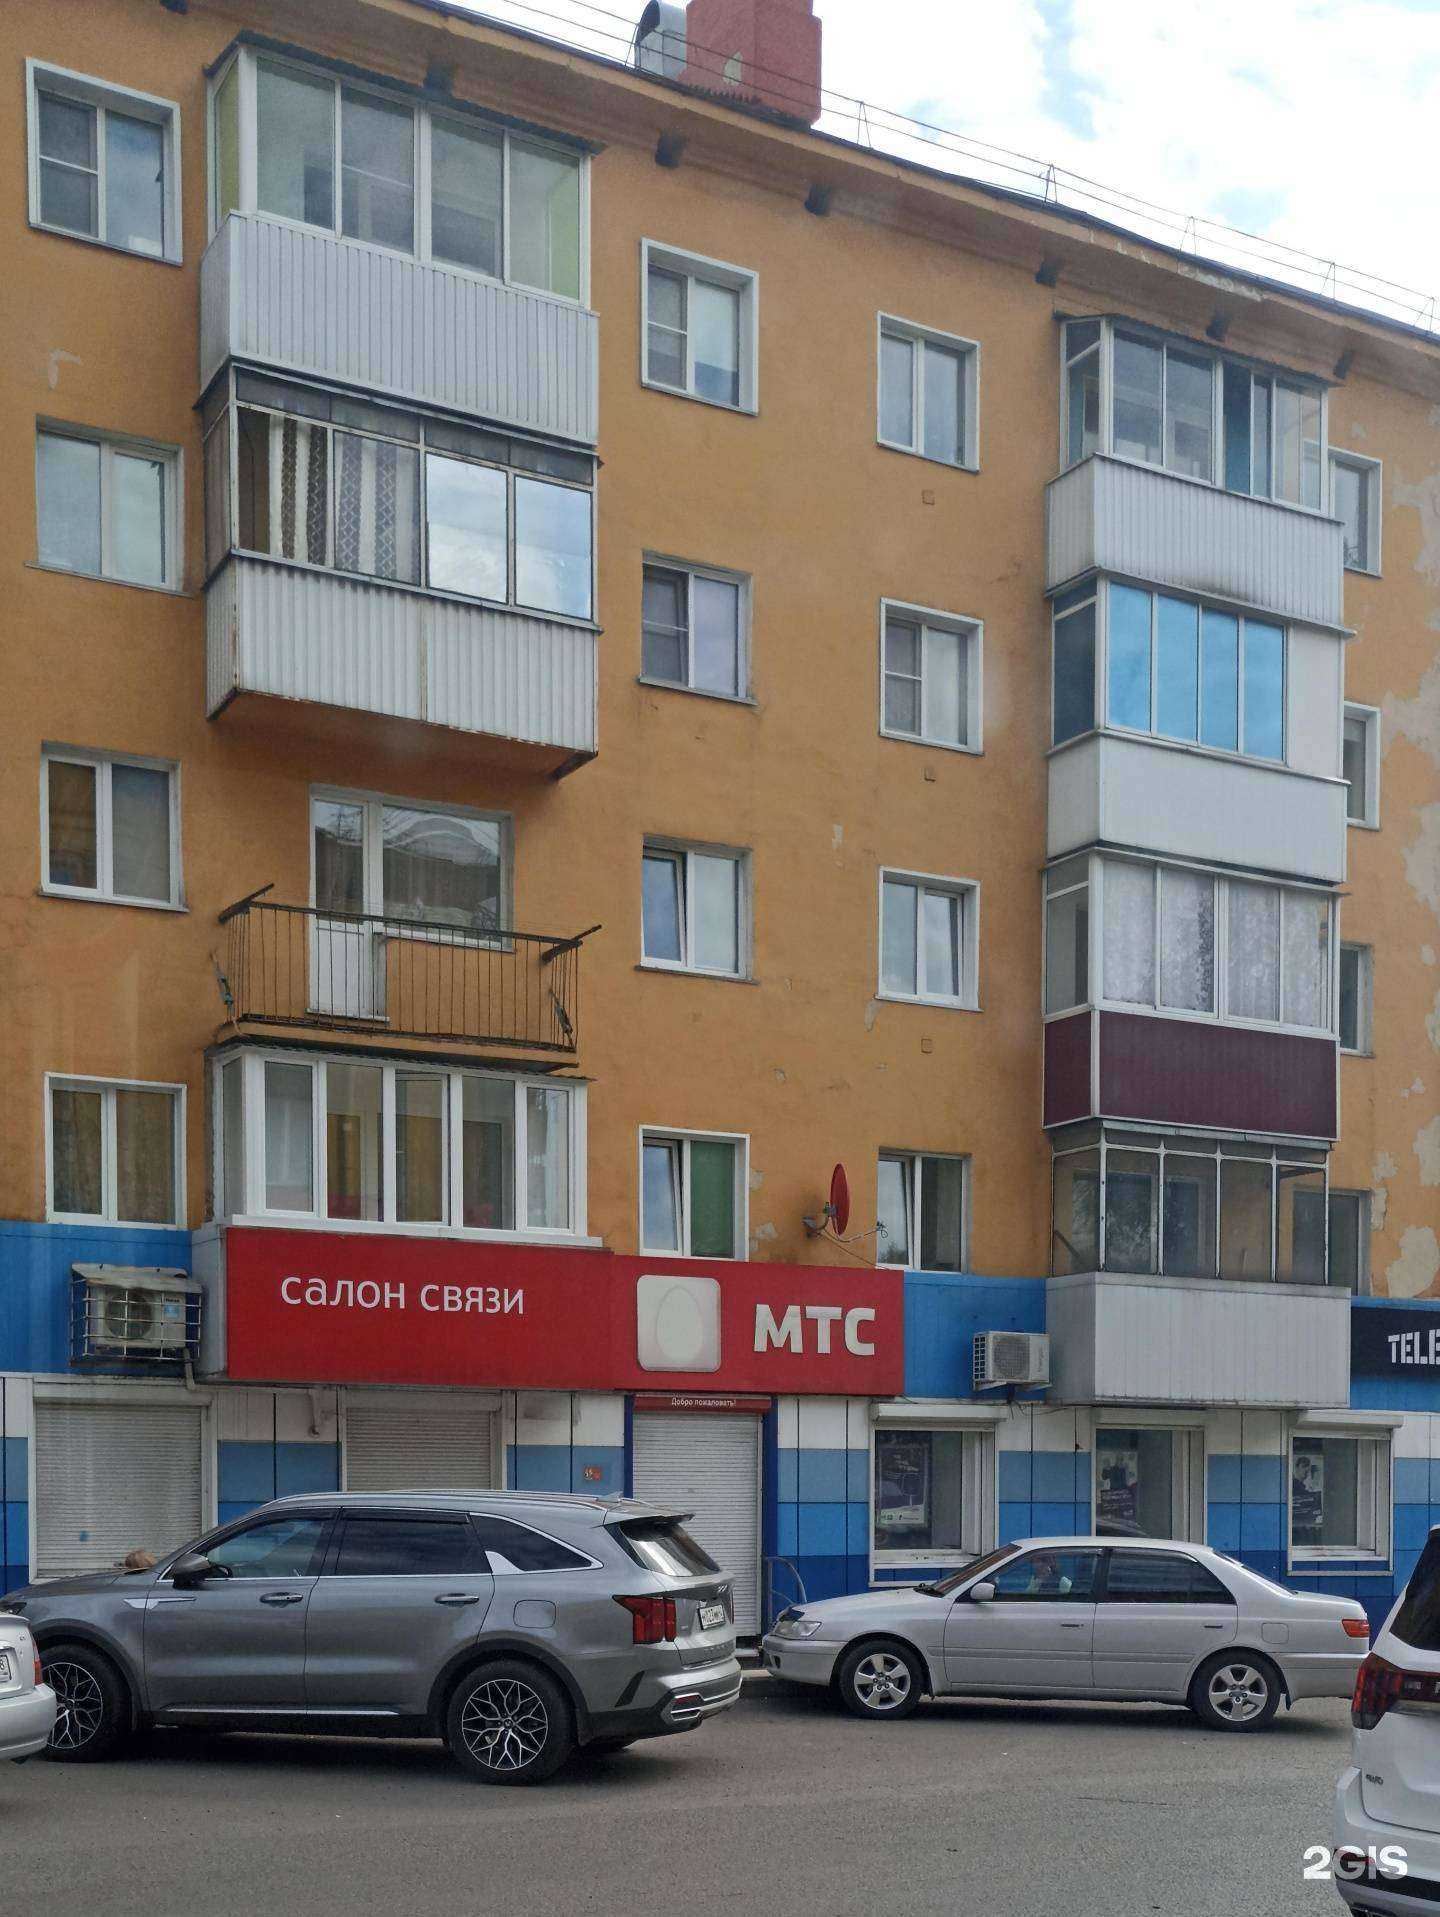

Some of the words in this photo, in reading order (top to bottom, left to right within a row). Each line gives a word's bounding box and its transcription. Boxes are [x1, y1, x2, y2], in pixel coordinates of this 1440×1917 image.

[420, 1284, 524, 1315] связи
[754, 1303, 876, 1356] МТС
[1388, 1329, 1440, 1365] TELE
[671, 1397, 694, 1407] Добро
